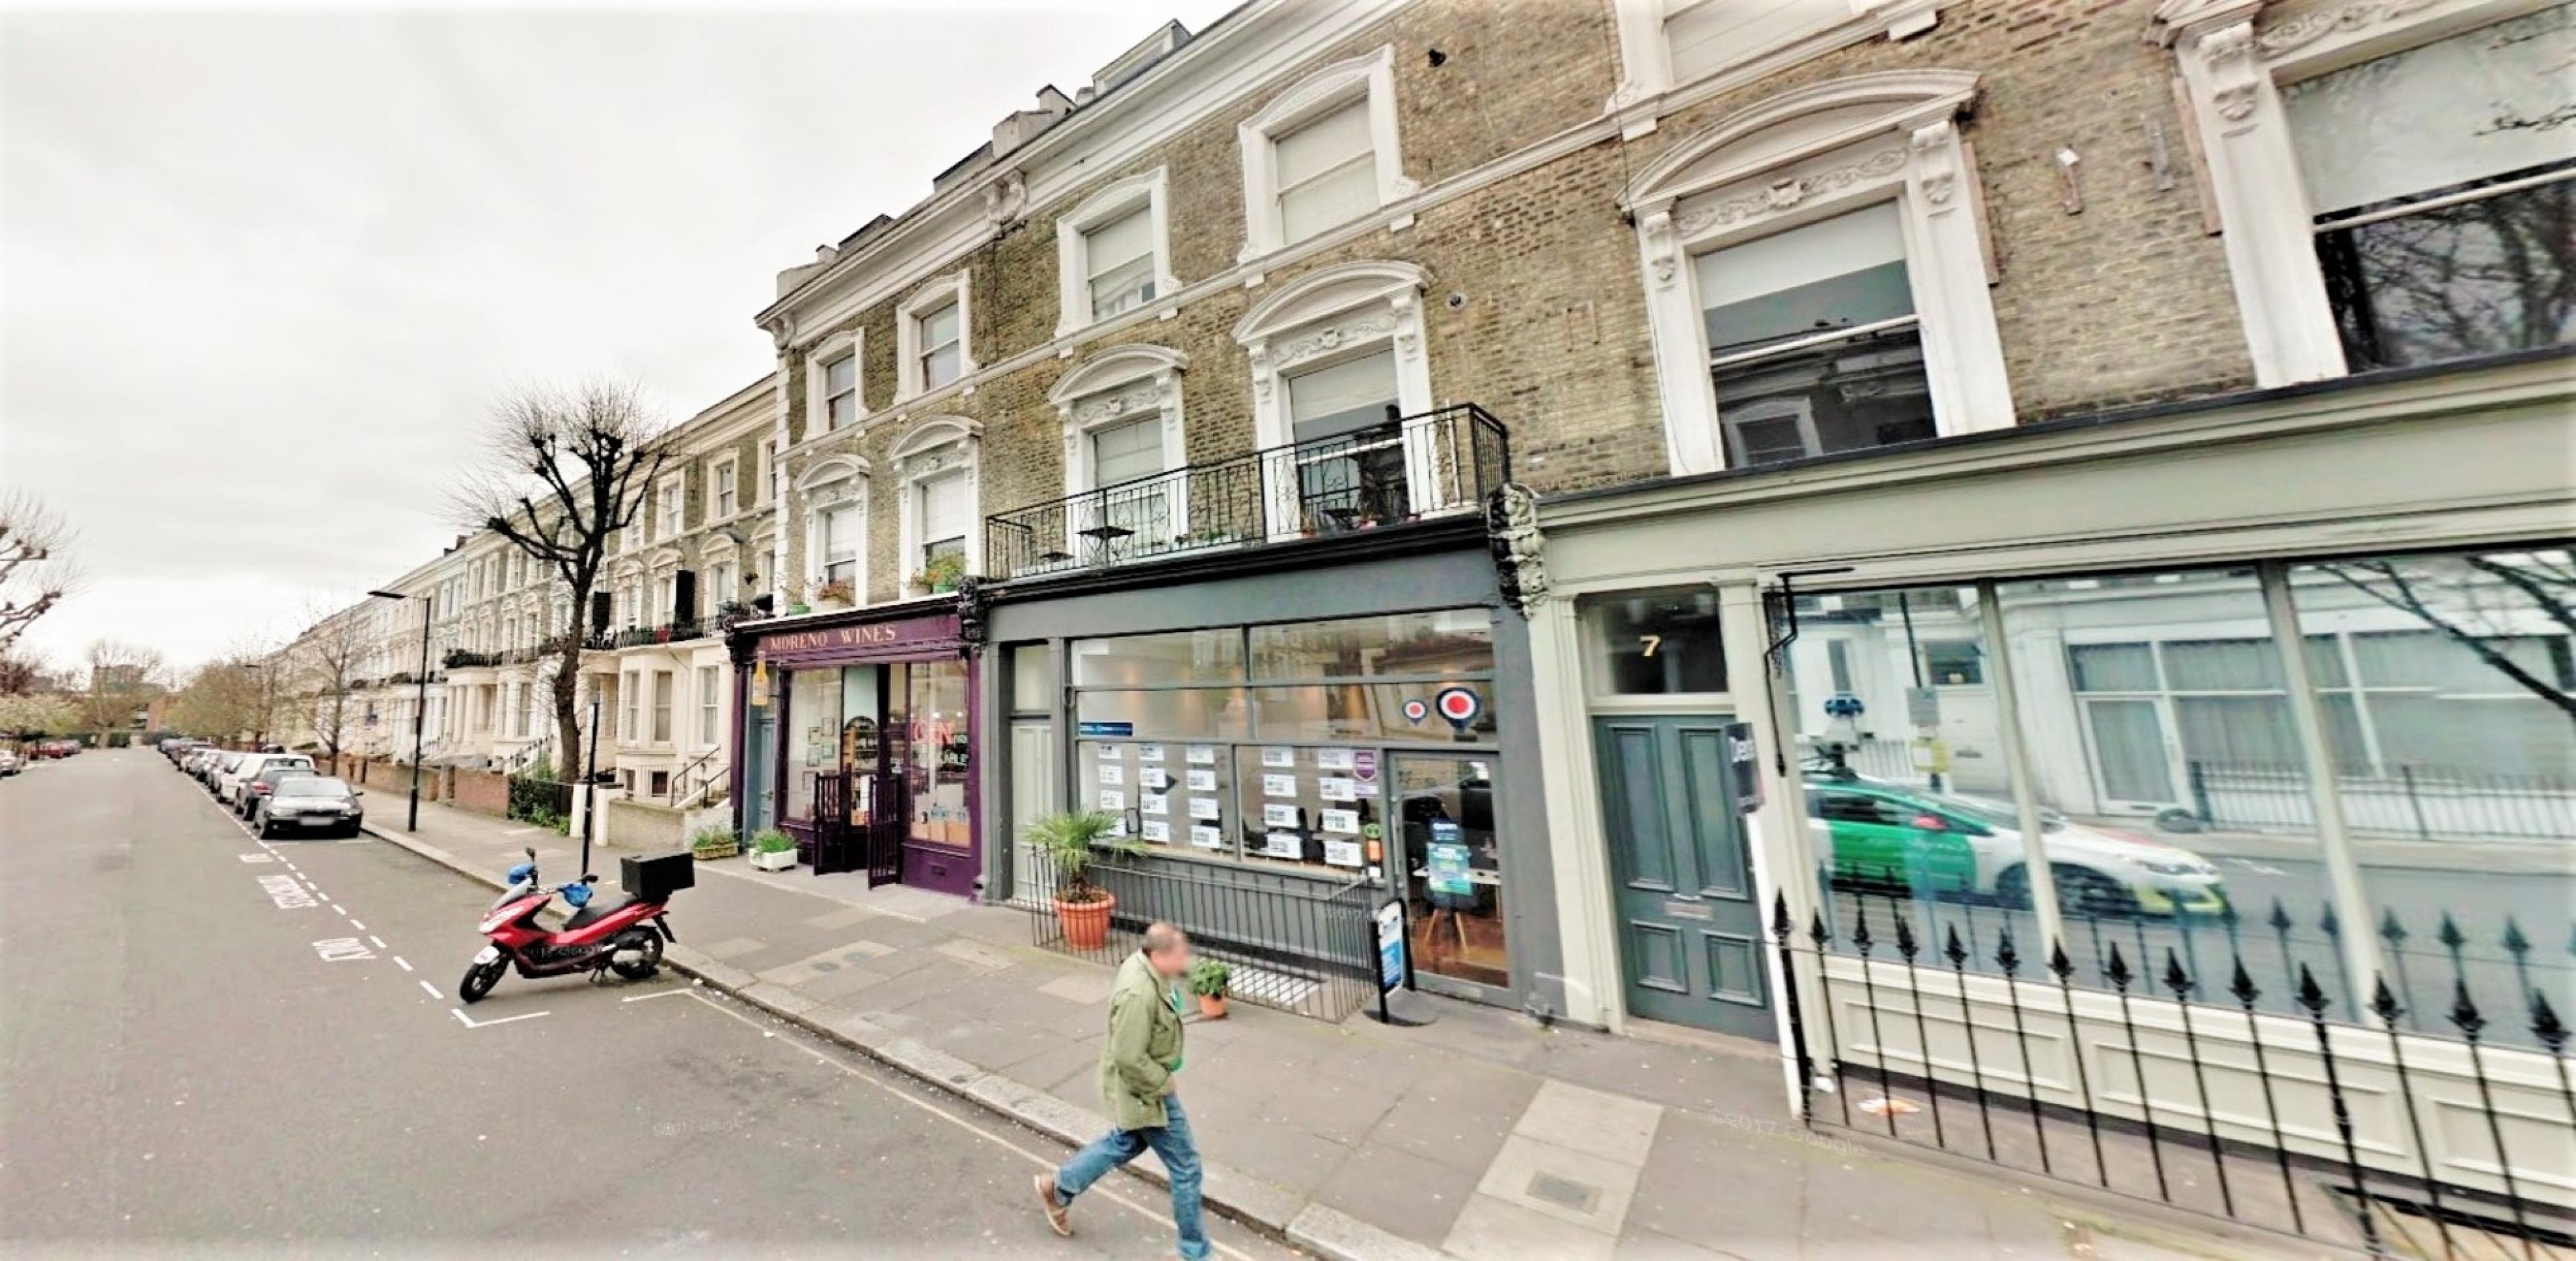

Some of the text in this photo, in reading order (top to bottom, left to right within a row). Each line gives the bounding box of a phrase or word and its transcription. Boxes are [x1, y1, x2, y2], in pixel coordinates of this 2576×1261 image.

[769, 625, 896, 651] MORENO WINES
[1639, 634, 1661, 657] 7
